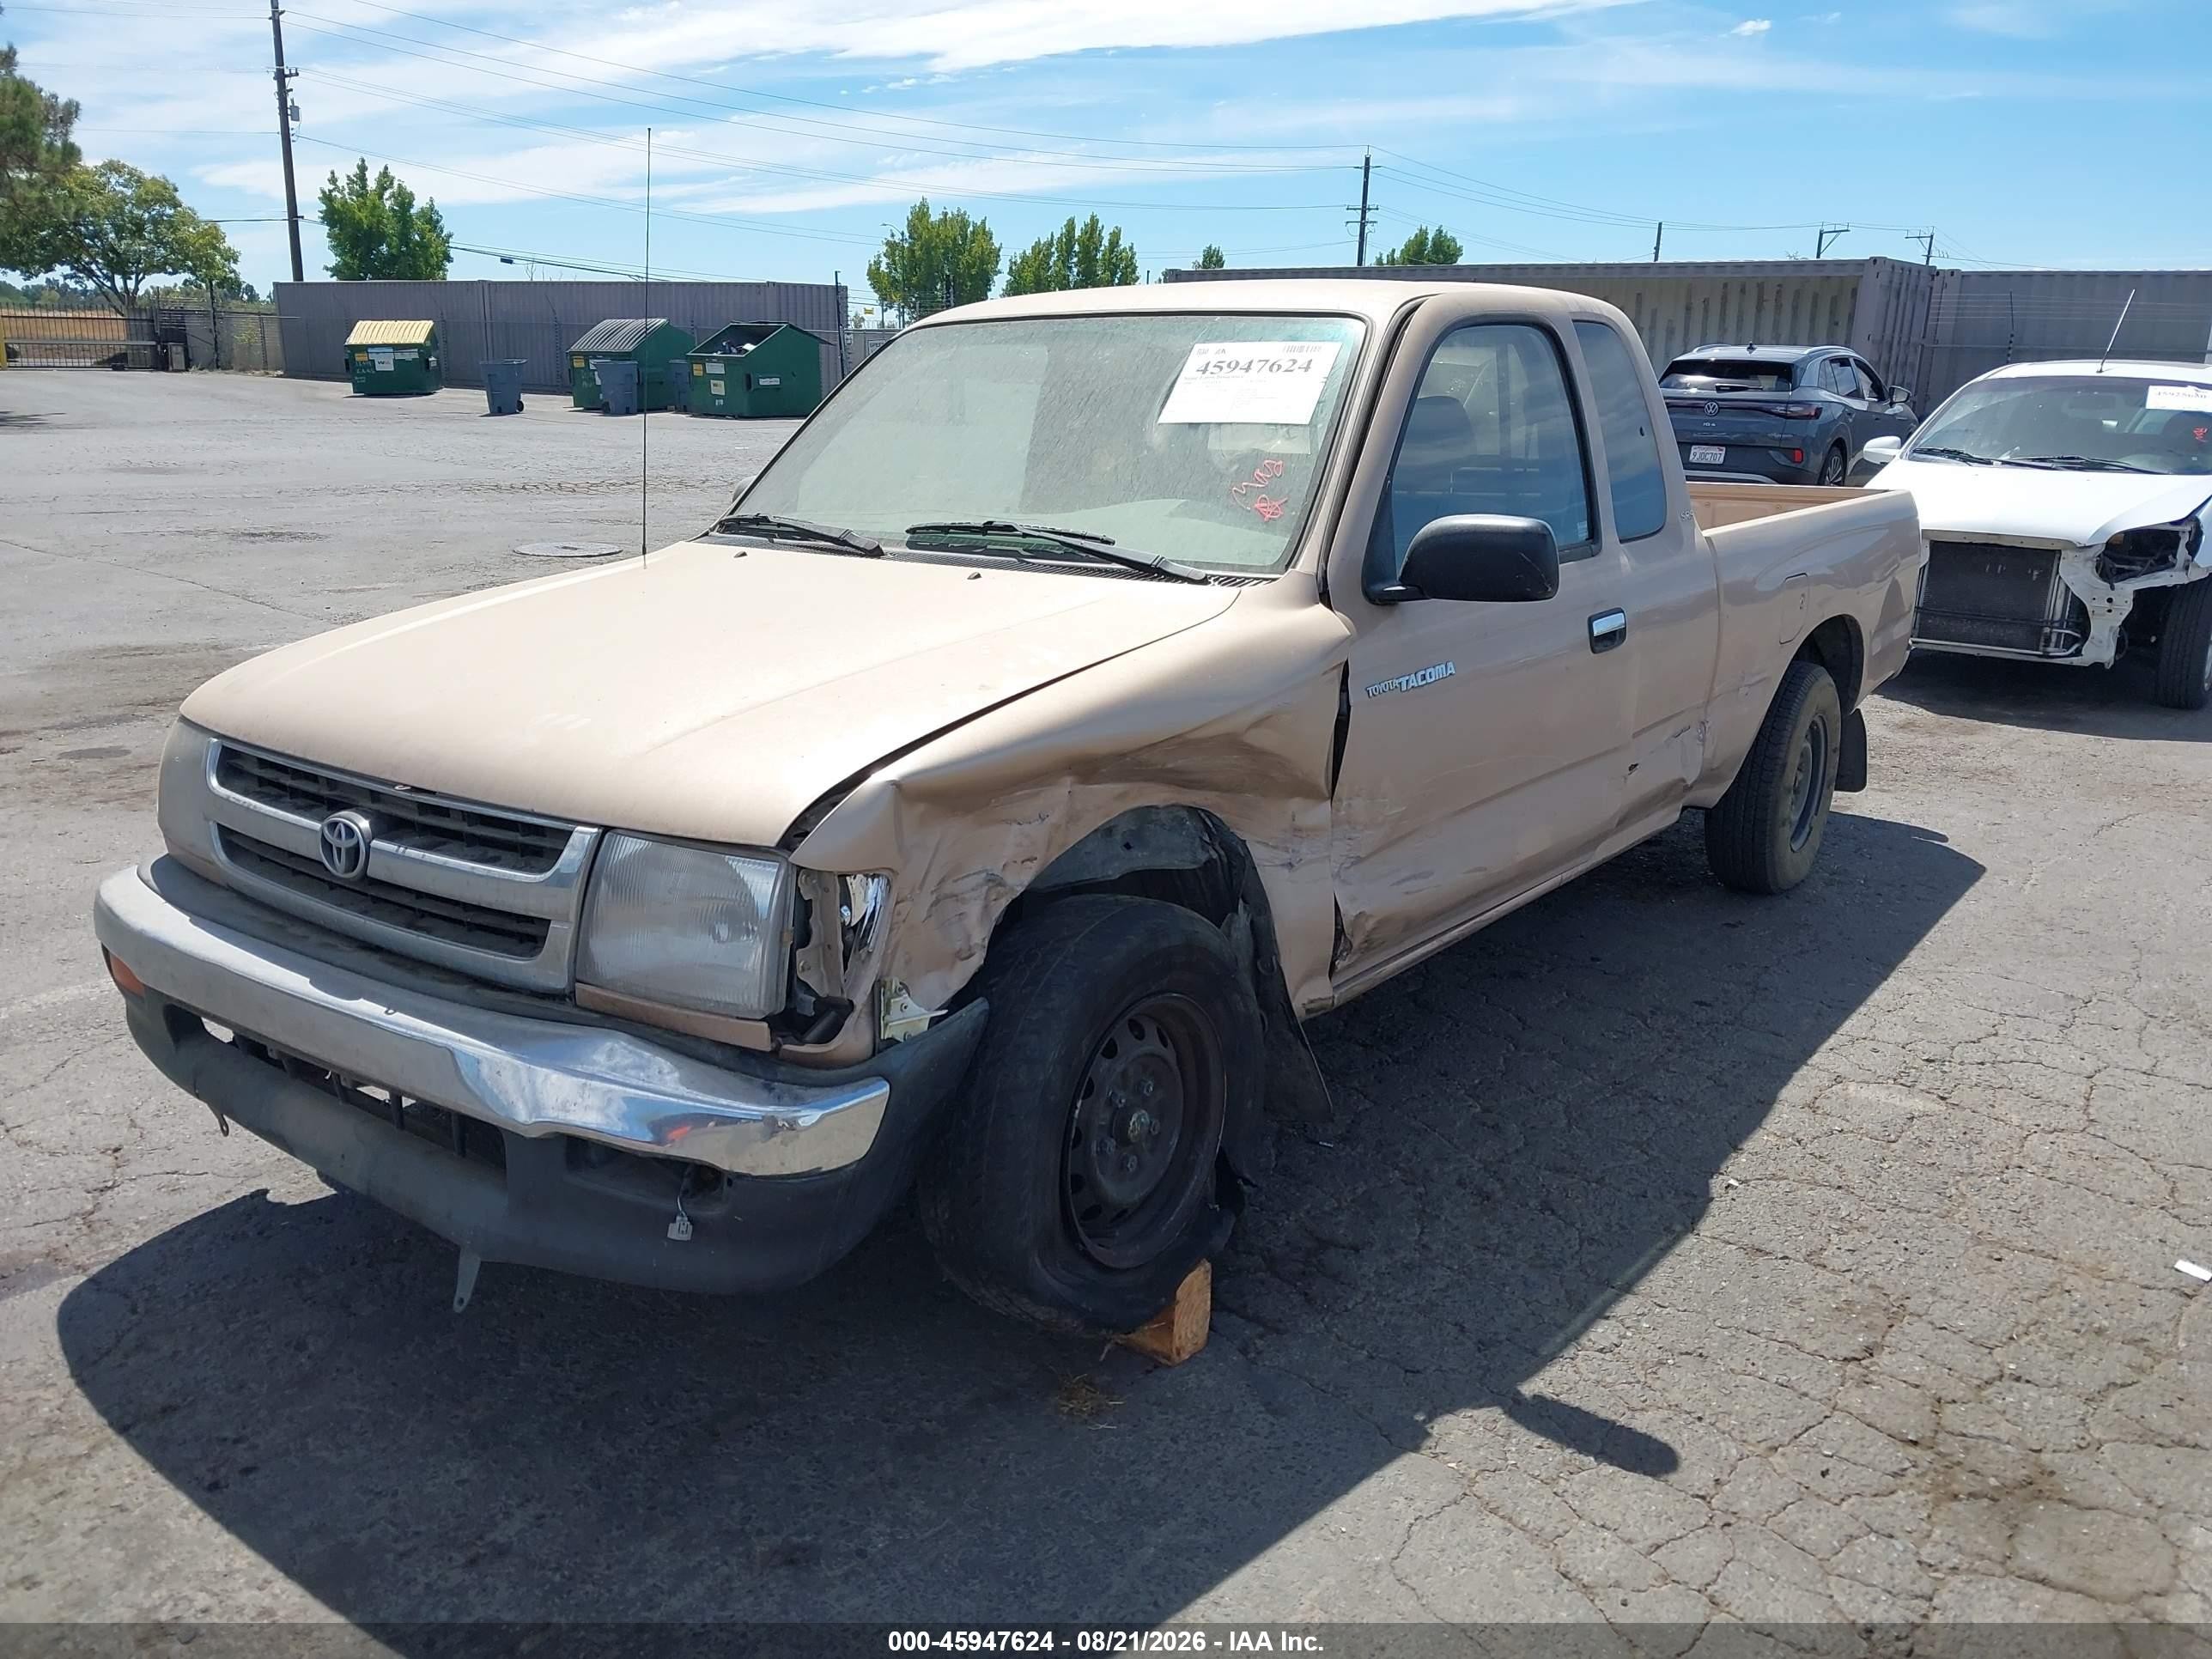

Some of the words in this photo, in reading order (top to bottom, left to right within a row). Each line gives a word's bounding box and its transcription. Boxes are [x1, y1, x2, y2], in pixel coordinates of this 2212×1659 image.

[1196, 358, 1313, 374] 45947624
[1365, 678, 1399, 698] TOYOTA
[1397, 660, 1456, 692] TACOMA
